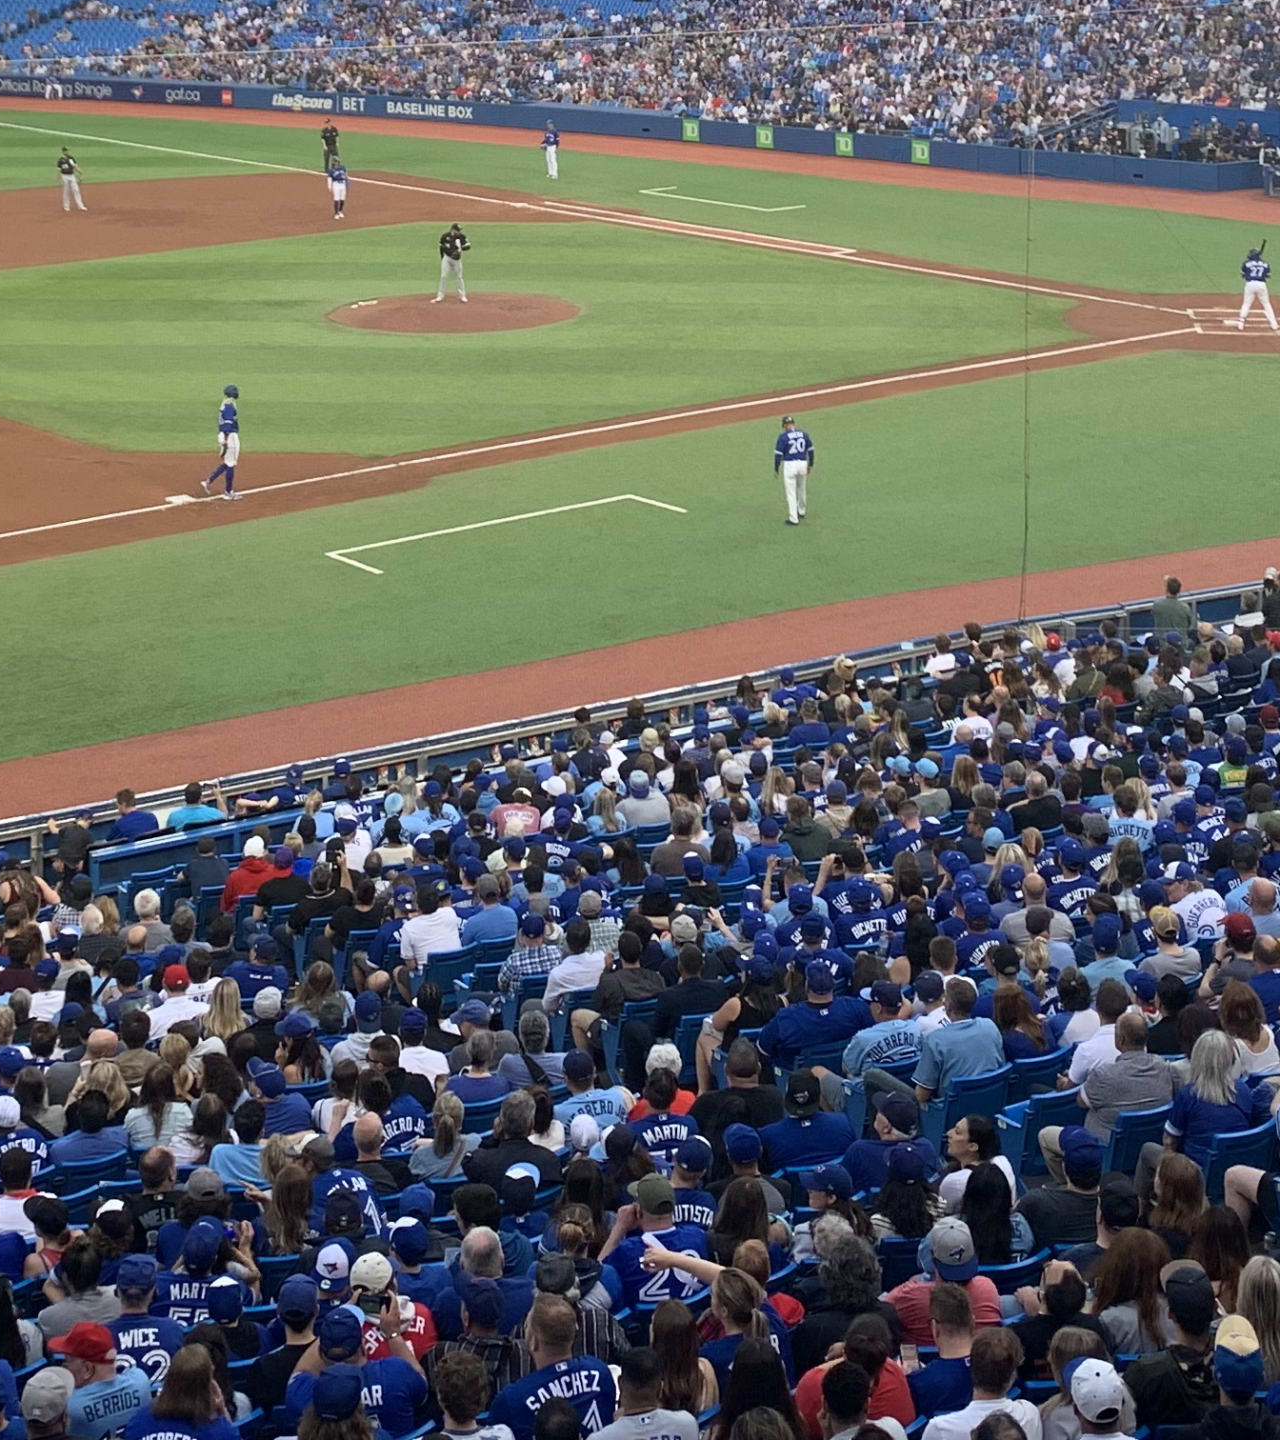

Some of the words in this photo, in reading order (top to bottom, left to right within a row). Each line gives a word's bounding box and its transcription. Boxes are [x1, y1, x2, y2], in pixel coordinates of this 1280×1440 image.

[74, 82, 112, 98] Shingle
[272, 93, 333, 109] theScore
[343, 97, 365, 112] BET
[386, 98, 446, 118] BASELINE
[448, 104, 473, 120] BOX
[788, 438, 806, 454] 20
[642, 1123, 688, 1146] MARTIN
[117, 1328, 160, 1348] WICE
[526, 1370, 600, 1414] SANCHEZ
